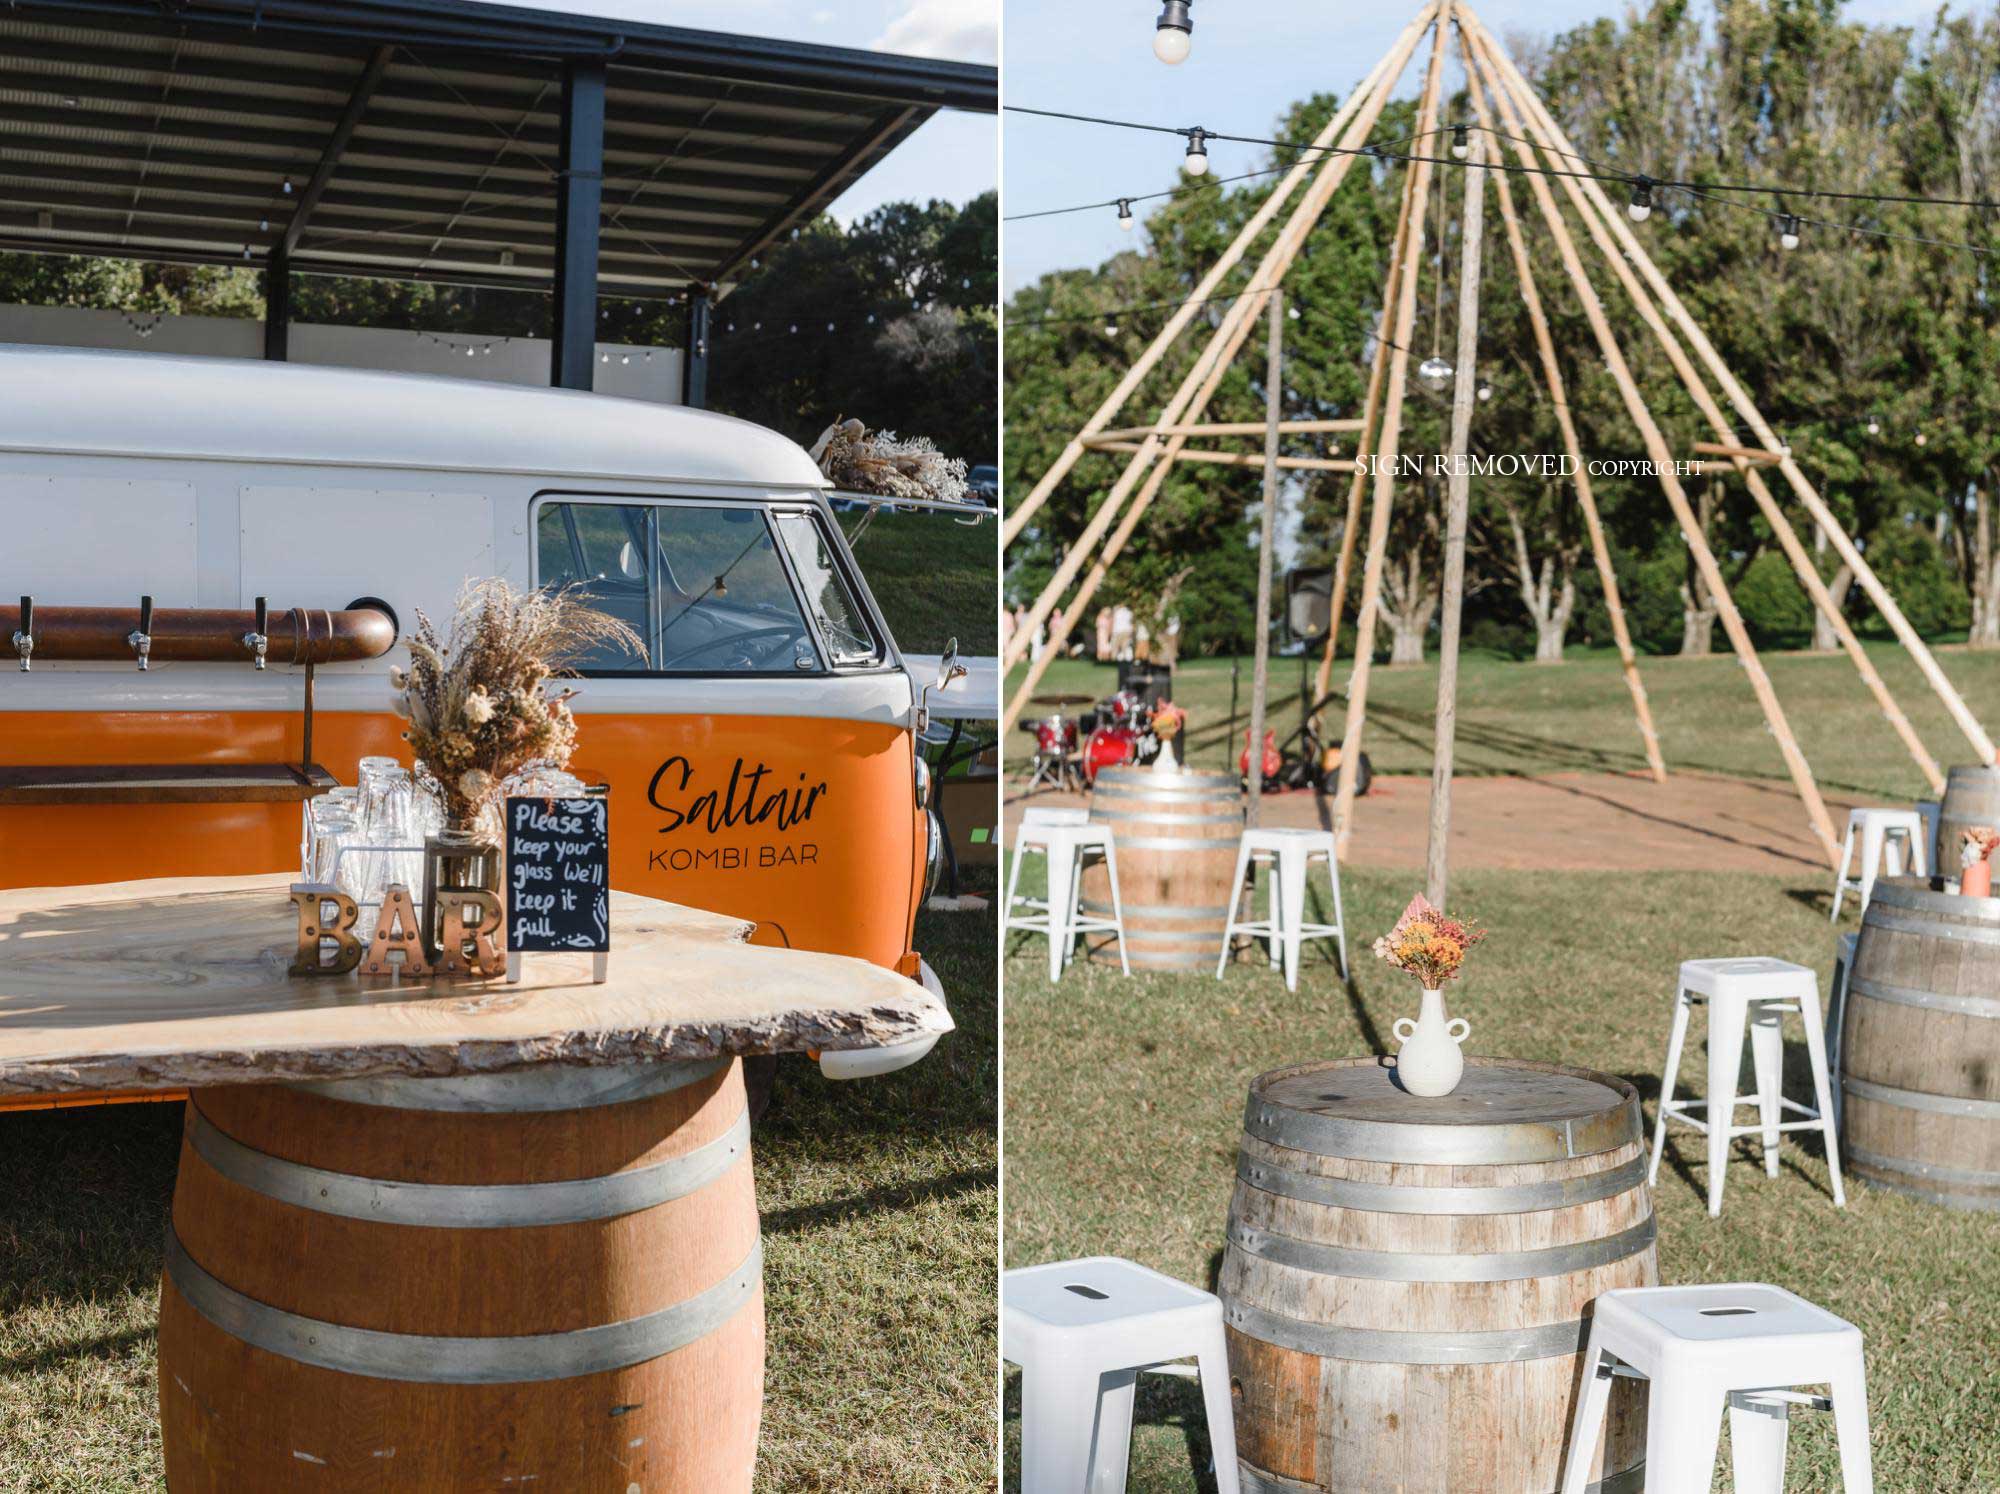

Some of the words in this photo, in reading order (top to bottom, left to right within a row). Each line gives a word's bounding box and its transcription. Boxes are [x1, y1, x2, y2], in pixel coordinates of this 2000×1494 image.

[648, 756, 827, 834] Saltair
[514, 804, 584, 834] Please
[554, 840, 595, 862] your
[649, 847, 749, 871] KOMBI
[759, 844, 818, 867] BAR
[513, 863, 553, 889] glass
[563, 863, 603, 886] We'll
[560, 888, 578, 911] it
[288, 883, 507, 978] BAR
